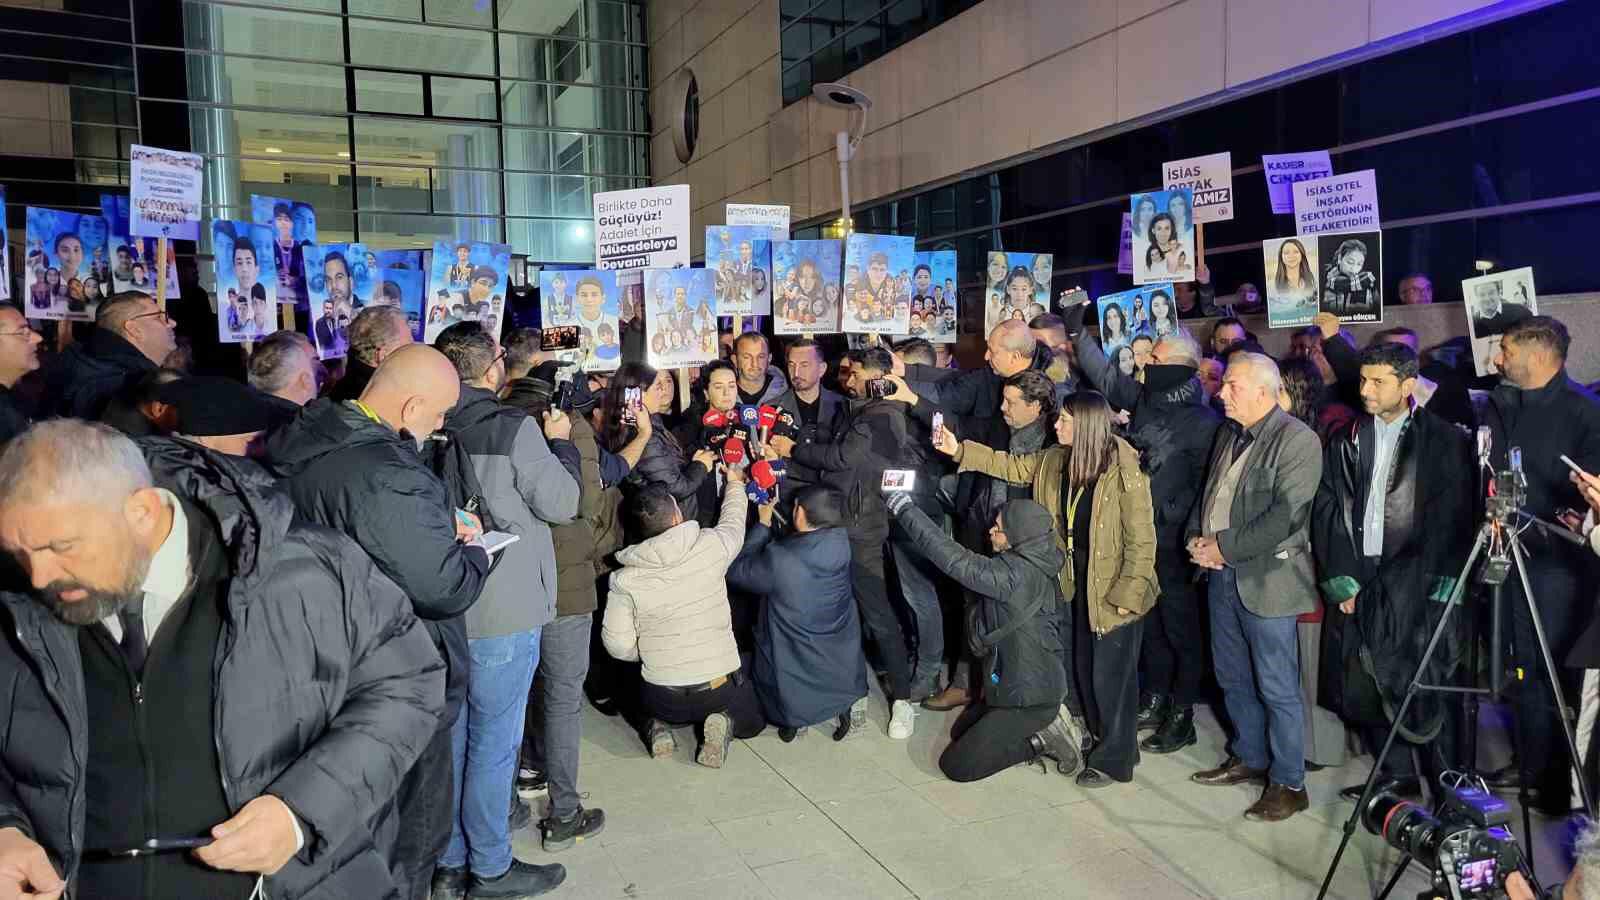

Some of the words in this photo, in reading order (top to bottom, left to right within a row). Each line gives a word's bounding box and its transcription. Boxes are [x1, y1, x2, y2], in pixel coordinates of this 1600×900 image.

[1167, 166, 1201, 181] İSİAS
[1306, 184, 1333, 197] İSİAS
[1335, 180, 1362, 192] OTEL
[599, 200, 638, 213] Birlikte
[640, 197, 672, 209] Daha
[1192, 190, 1229, 207] AMIZ
[599, 210, 662, 228] Güçlüyüz!
[1301, 203, 1373, 223] SEKTÖRÜNÜN
[600, 228, 640, 241] Adalet
[641, 224, 662, 238] İçin
[600, 239, 677, 257] Mücadeleye
[601, 256, 651, 270] Devam!
